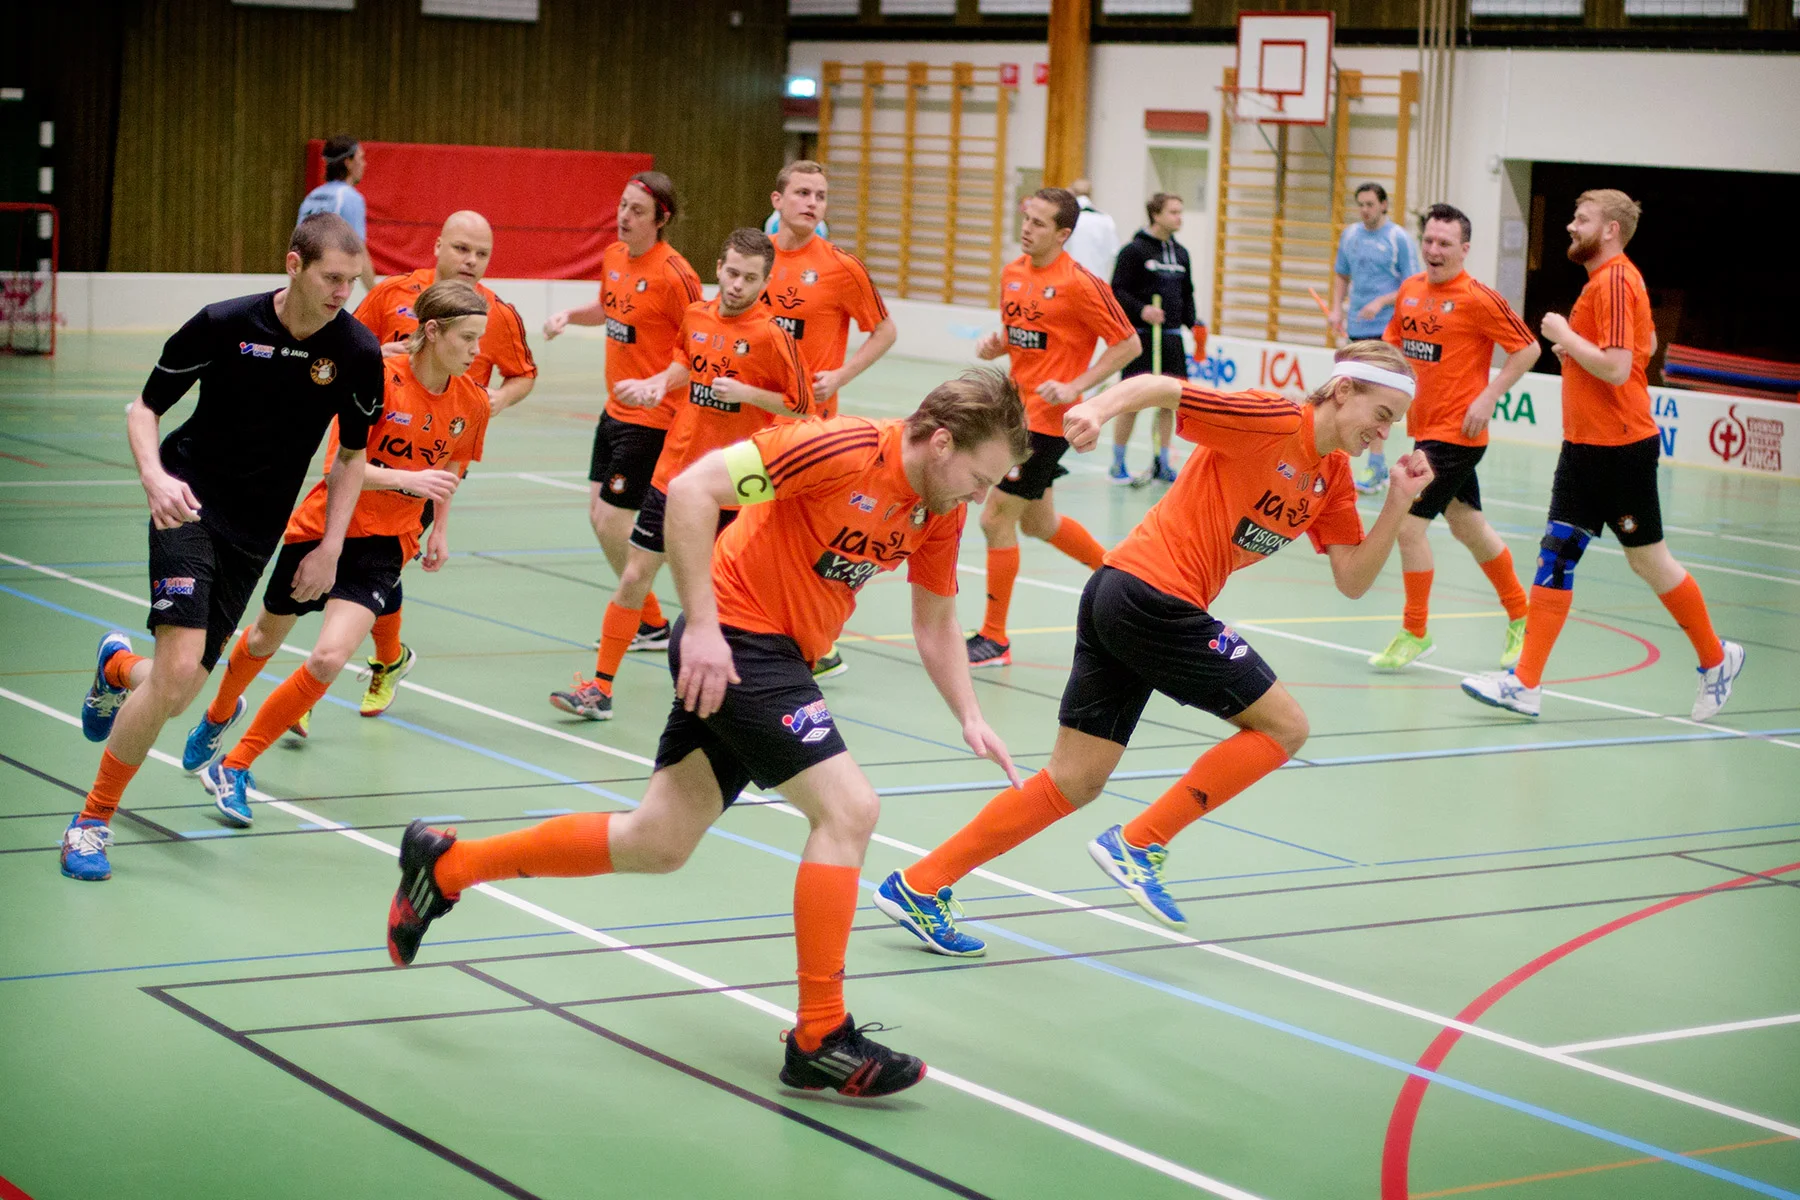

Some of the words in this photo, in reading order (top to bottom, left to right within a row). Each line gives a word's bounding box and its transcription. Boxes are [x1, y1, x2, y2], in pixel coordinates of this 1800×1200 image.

[604, 291, 617, 309] CA
[1005, 302, 1021, 317] CA
[1401, 316, 1417, 333] CA
[290, 350, 309, 359] JAKO
[1259, 350, 1305, 391] ICA
[421, 413, 434, 433] 2
[378, 435, 413, 460] ICA
[432, 439, 448, 453] SJ
[737, 474, 768, 498] C
[1253, 489, 1286, 521] ICA
[1298, 497, 1310, 515] SJ
[829, 526, 869, 556] ICA
[887, 531, 905, 550] SJ
[1245, 523, 1291, 549] VISION
[832, 555, 881, 579] VISION
[167, 586, 193, 595] SPORT
